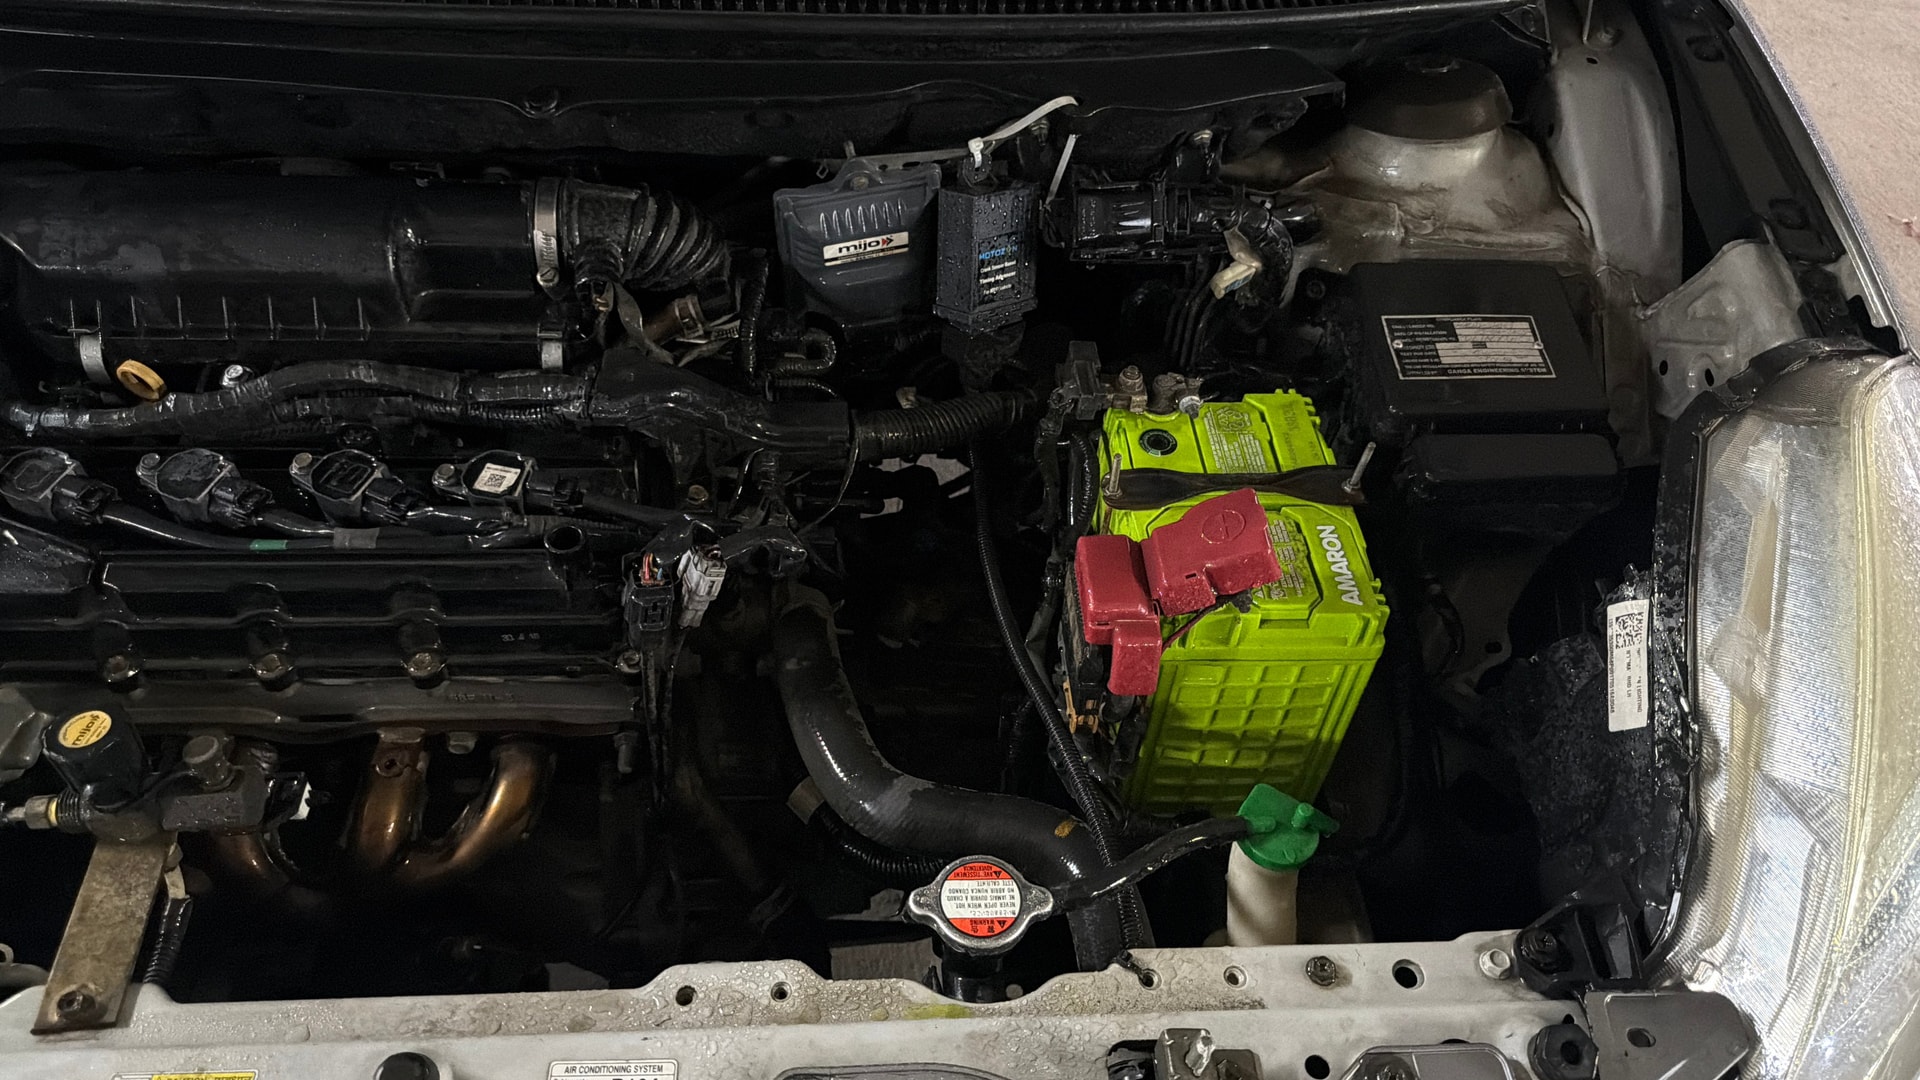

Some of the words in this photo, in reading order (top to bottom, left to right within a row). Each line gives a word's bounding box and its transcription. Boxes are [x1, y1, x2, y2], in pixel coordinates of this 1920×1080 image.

[838, 240, 880, 254] mijo
[1316, 525, 1363, 606] AMARON
[579, 1065, 631, 1073] CONDITIONING
[634, 1065, 663, 1073] SYSTEM
